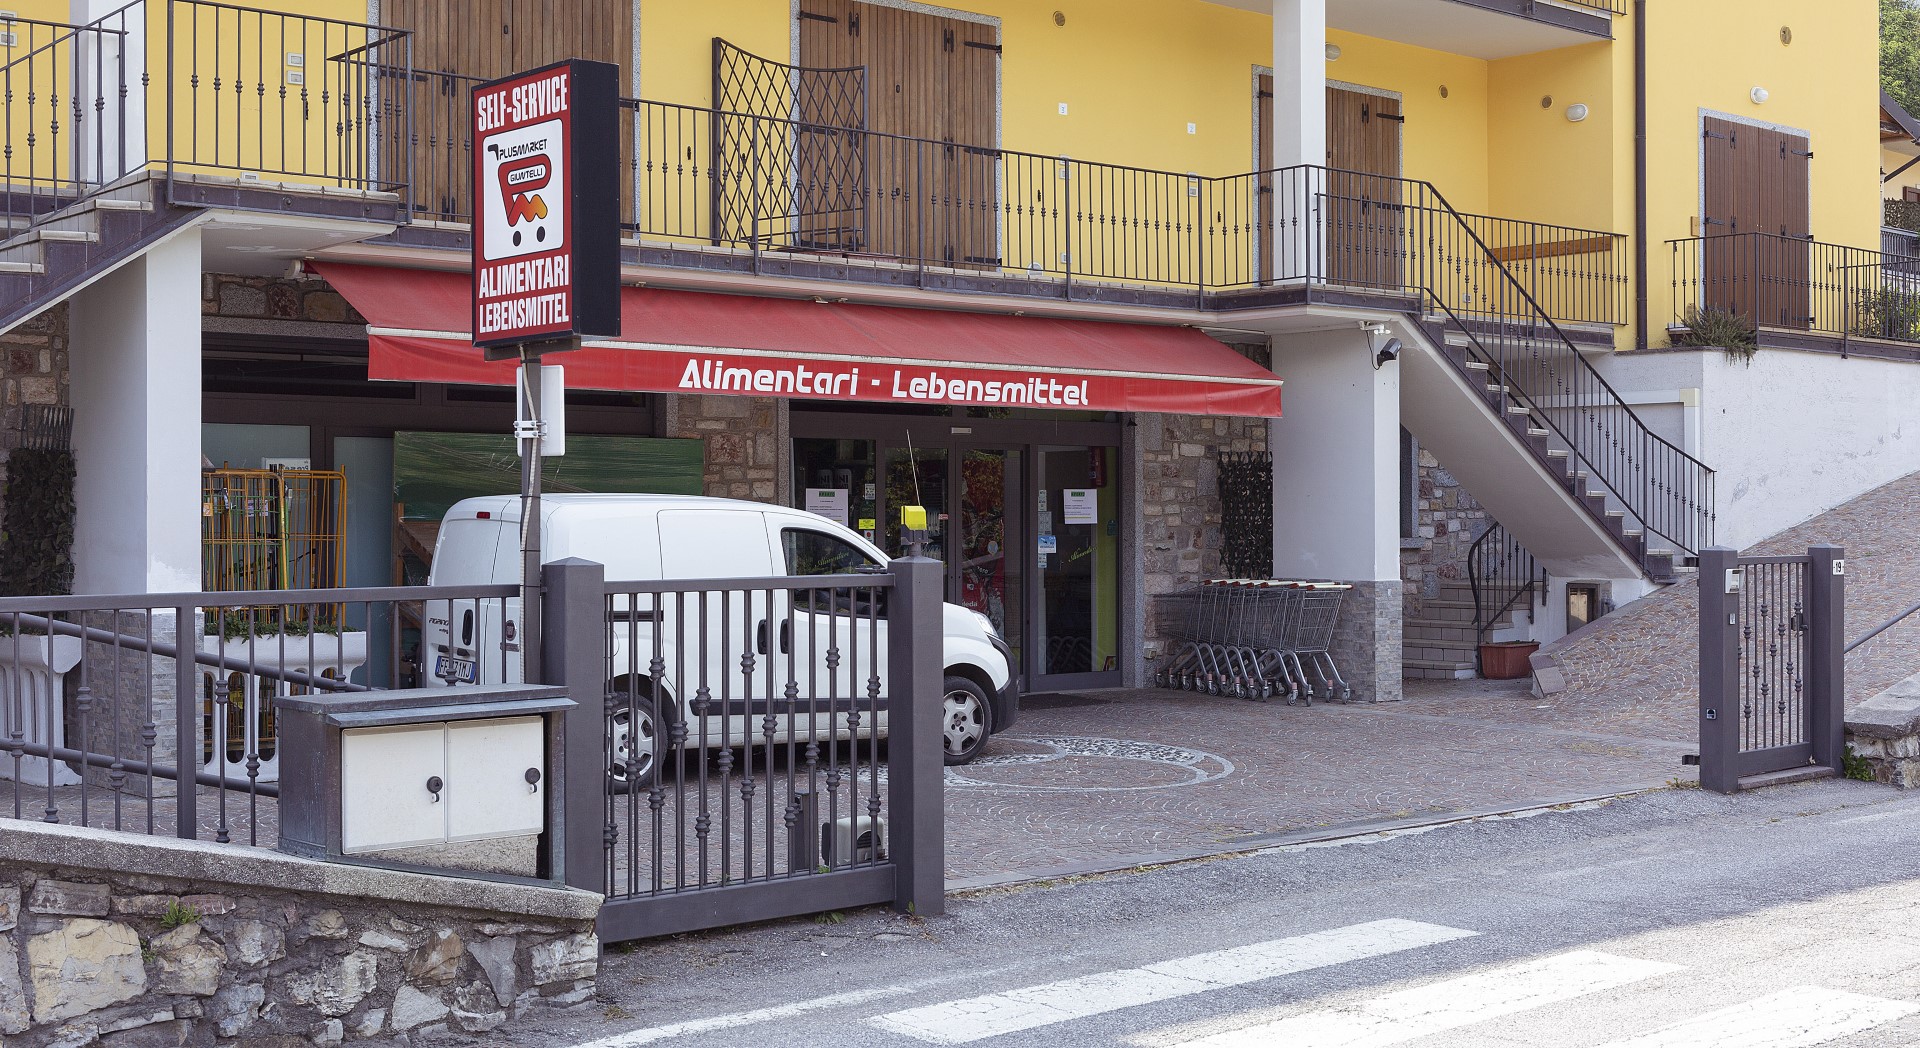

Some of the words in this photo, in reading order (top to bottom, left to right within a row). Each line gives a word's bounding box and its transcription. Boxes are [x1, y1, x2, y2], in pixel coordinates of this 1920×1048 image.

[478, 74, 568, 131] SELF-SERVICE
[499, 138, 548, 160] PLUSMARKET
[478, 254, 569, 299] ALIMENTARI
[479, 292, 569, 334] LEBENSMITTEL
[678, 359, 858, 396] Alimentari
[892, 370, 1088, 406] Lebensmittel
[1836, 562, 1842, 573] 19
